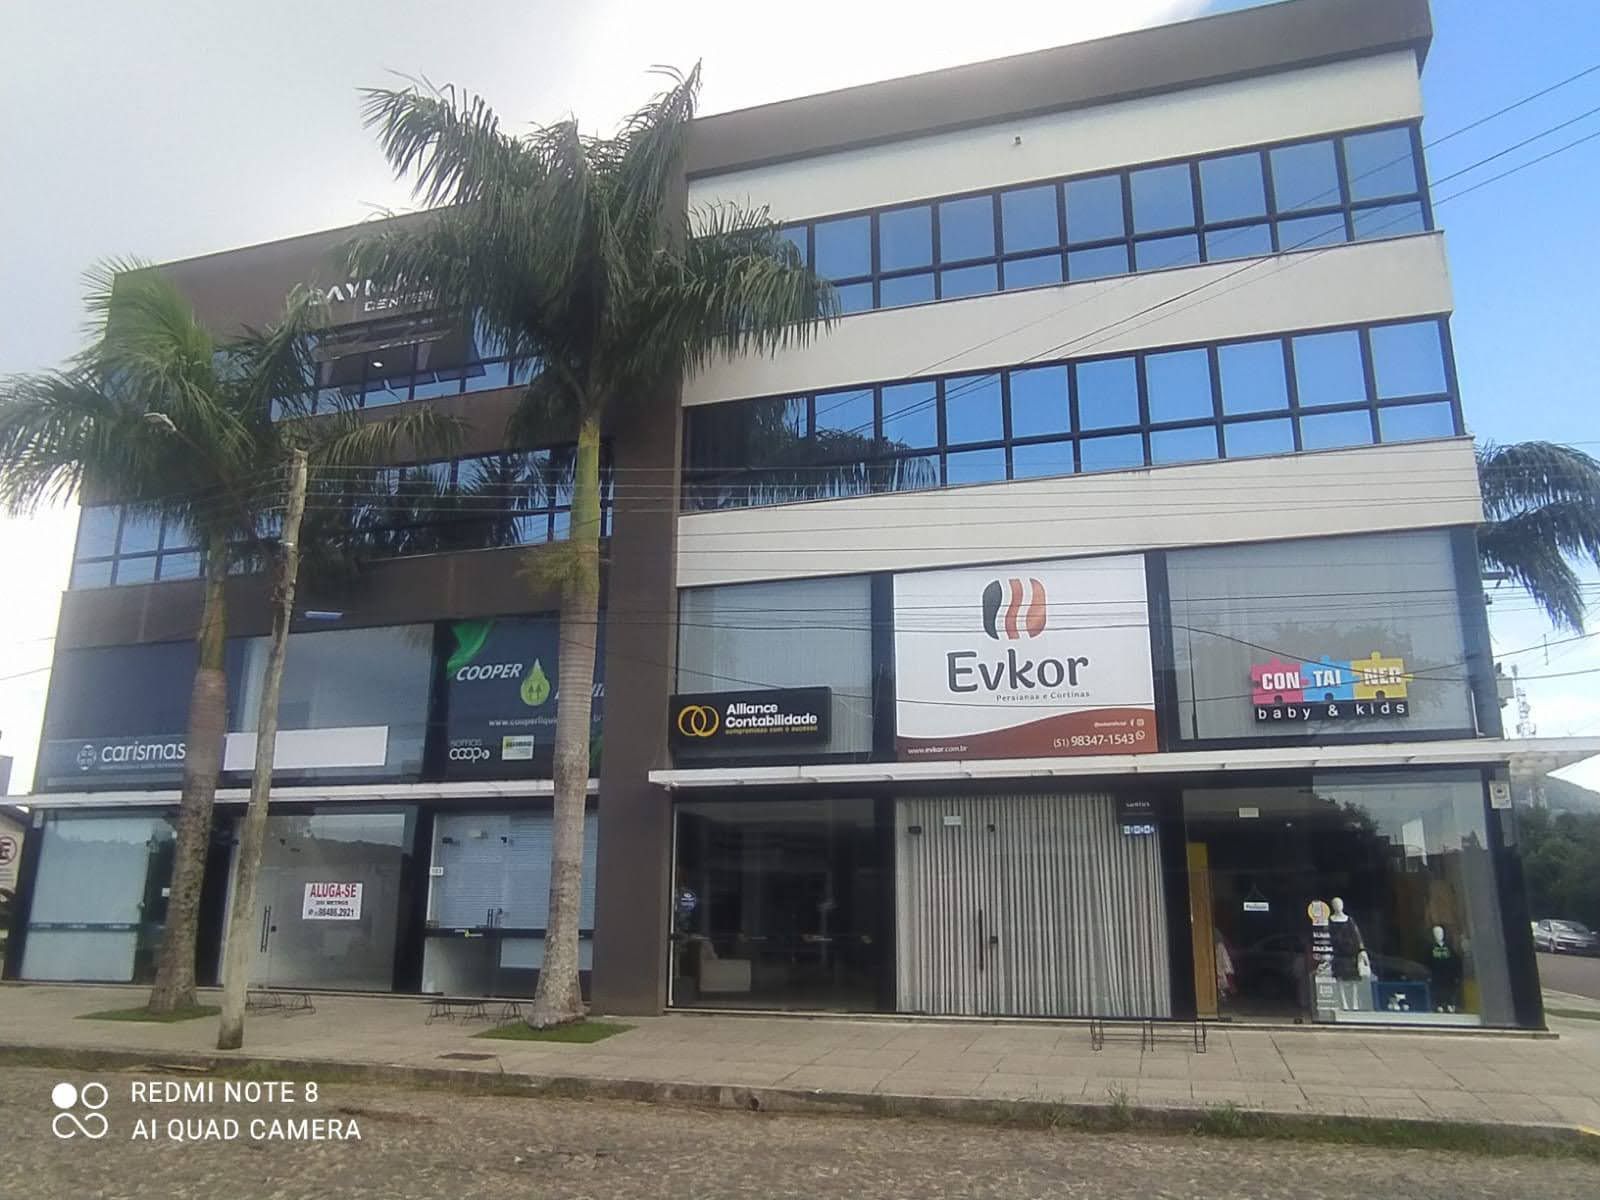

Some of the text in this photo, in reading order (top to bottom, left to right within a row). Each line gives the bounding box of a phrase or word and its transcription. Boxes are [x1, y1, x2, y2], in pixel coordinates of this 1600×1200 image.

[456, 663, 523, 681] COOPER
[947, 648, 1089, 692] Evkor
[1262, 671, 1300, 690] CON
[726, 703, 778, 715] Alliance
[1258, 701, 1405, 719] baby & kids
[725, 713, 818, 728] Contabilidade
[1053, 733, 1135, 748] (51) 98347-1543
[310, 884, 356, 897] ALUGA-SE
